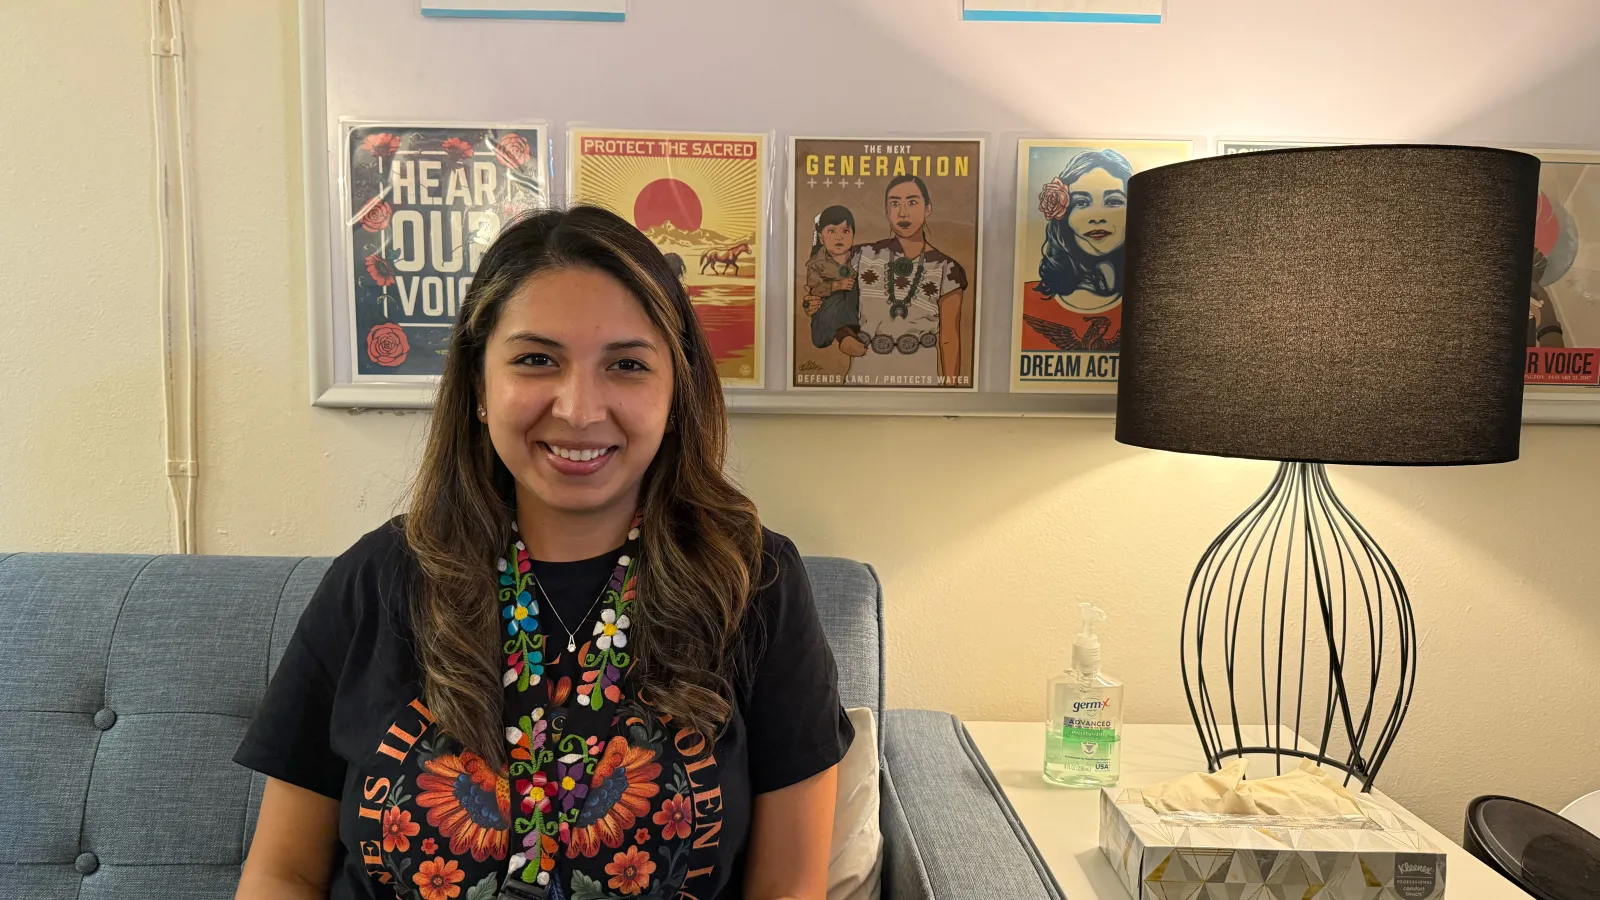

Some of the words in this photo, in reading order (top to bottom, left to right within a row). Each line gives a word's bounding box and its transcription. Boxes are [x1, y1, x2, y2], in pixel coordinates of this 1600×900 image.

[584, 139, 655, 154] PROTECT
[659, 141, 688, 155] THE
[692, 143, 754, 157] SACRED
[865, 145, 882, 153] THE
[887, 145, 911, 153] NEXT
[806, 155, 968, 177] GENERATION
[391, 160, 497, 205] HEAR
[1020, 355, 1081, 376] DREAM
[1086, 355, 1120, 377] ACT
[1544, 352, 1593, 374] VOICE
[798, 374, 841, 383] DEFENDS
[845, 375, 870, 384] LAND
[884, 376, 932, 384] PROTECTS
[937, 376, 969, 384] WATER
[1069, 719, 1111, 727] ADVANCED
[359, 776, 391, 824] IS
[1397, 862, 1433, 875] Kleenex
